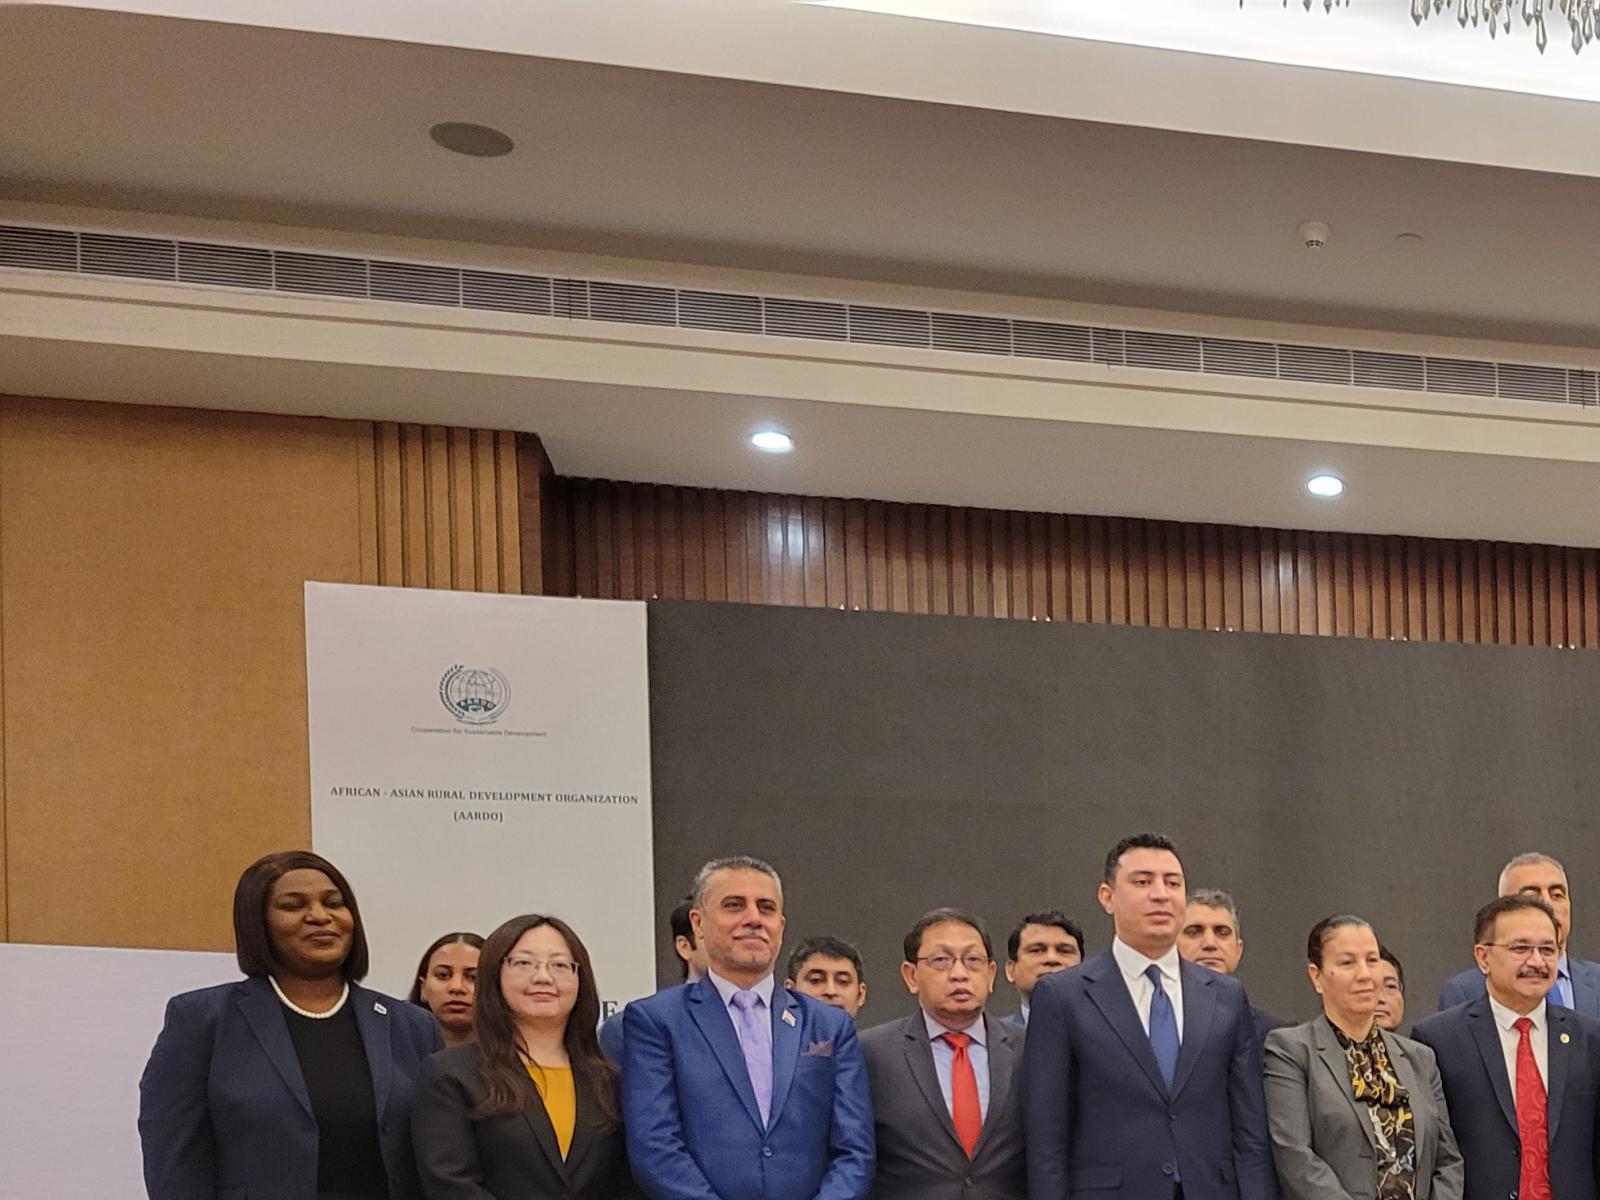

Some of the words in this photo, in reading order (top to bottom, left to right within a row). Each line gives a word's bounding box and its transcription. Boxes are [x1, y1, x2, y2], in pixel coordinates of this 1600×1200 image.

[331, 787, 380, 797] AFRICAN
[390, 789, 424, 799] ASIAN
[428, 790, 465, 800] RURAL
[469, 791, 552, 802] DEVELOPMENT
[555, 794, 638, 804] ORGANIZATION
